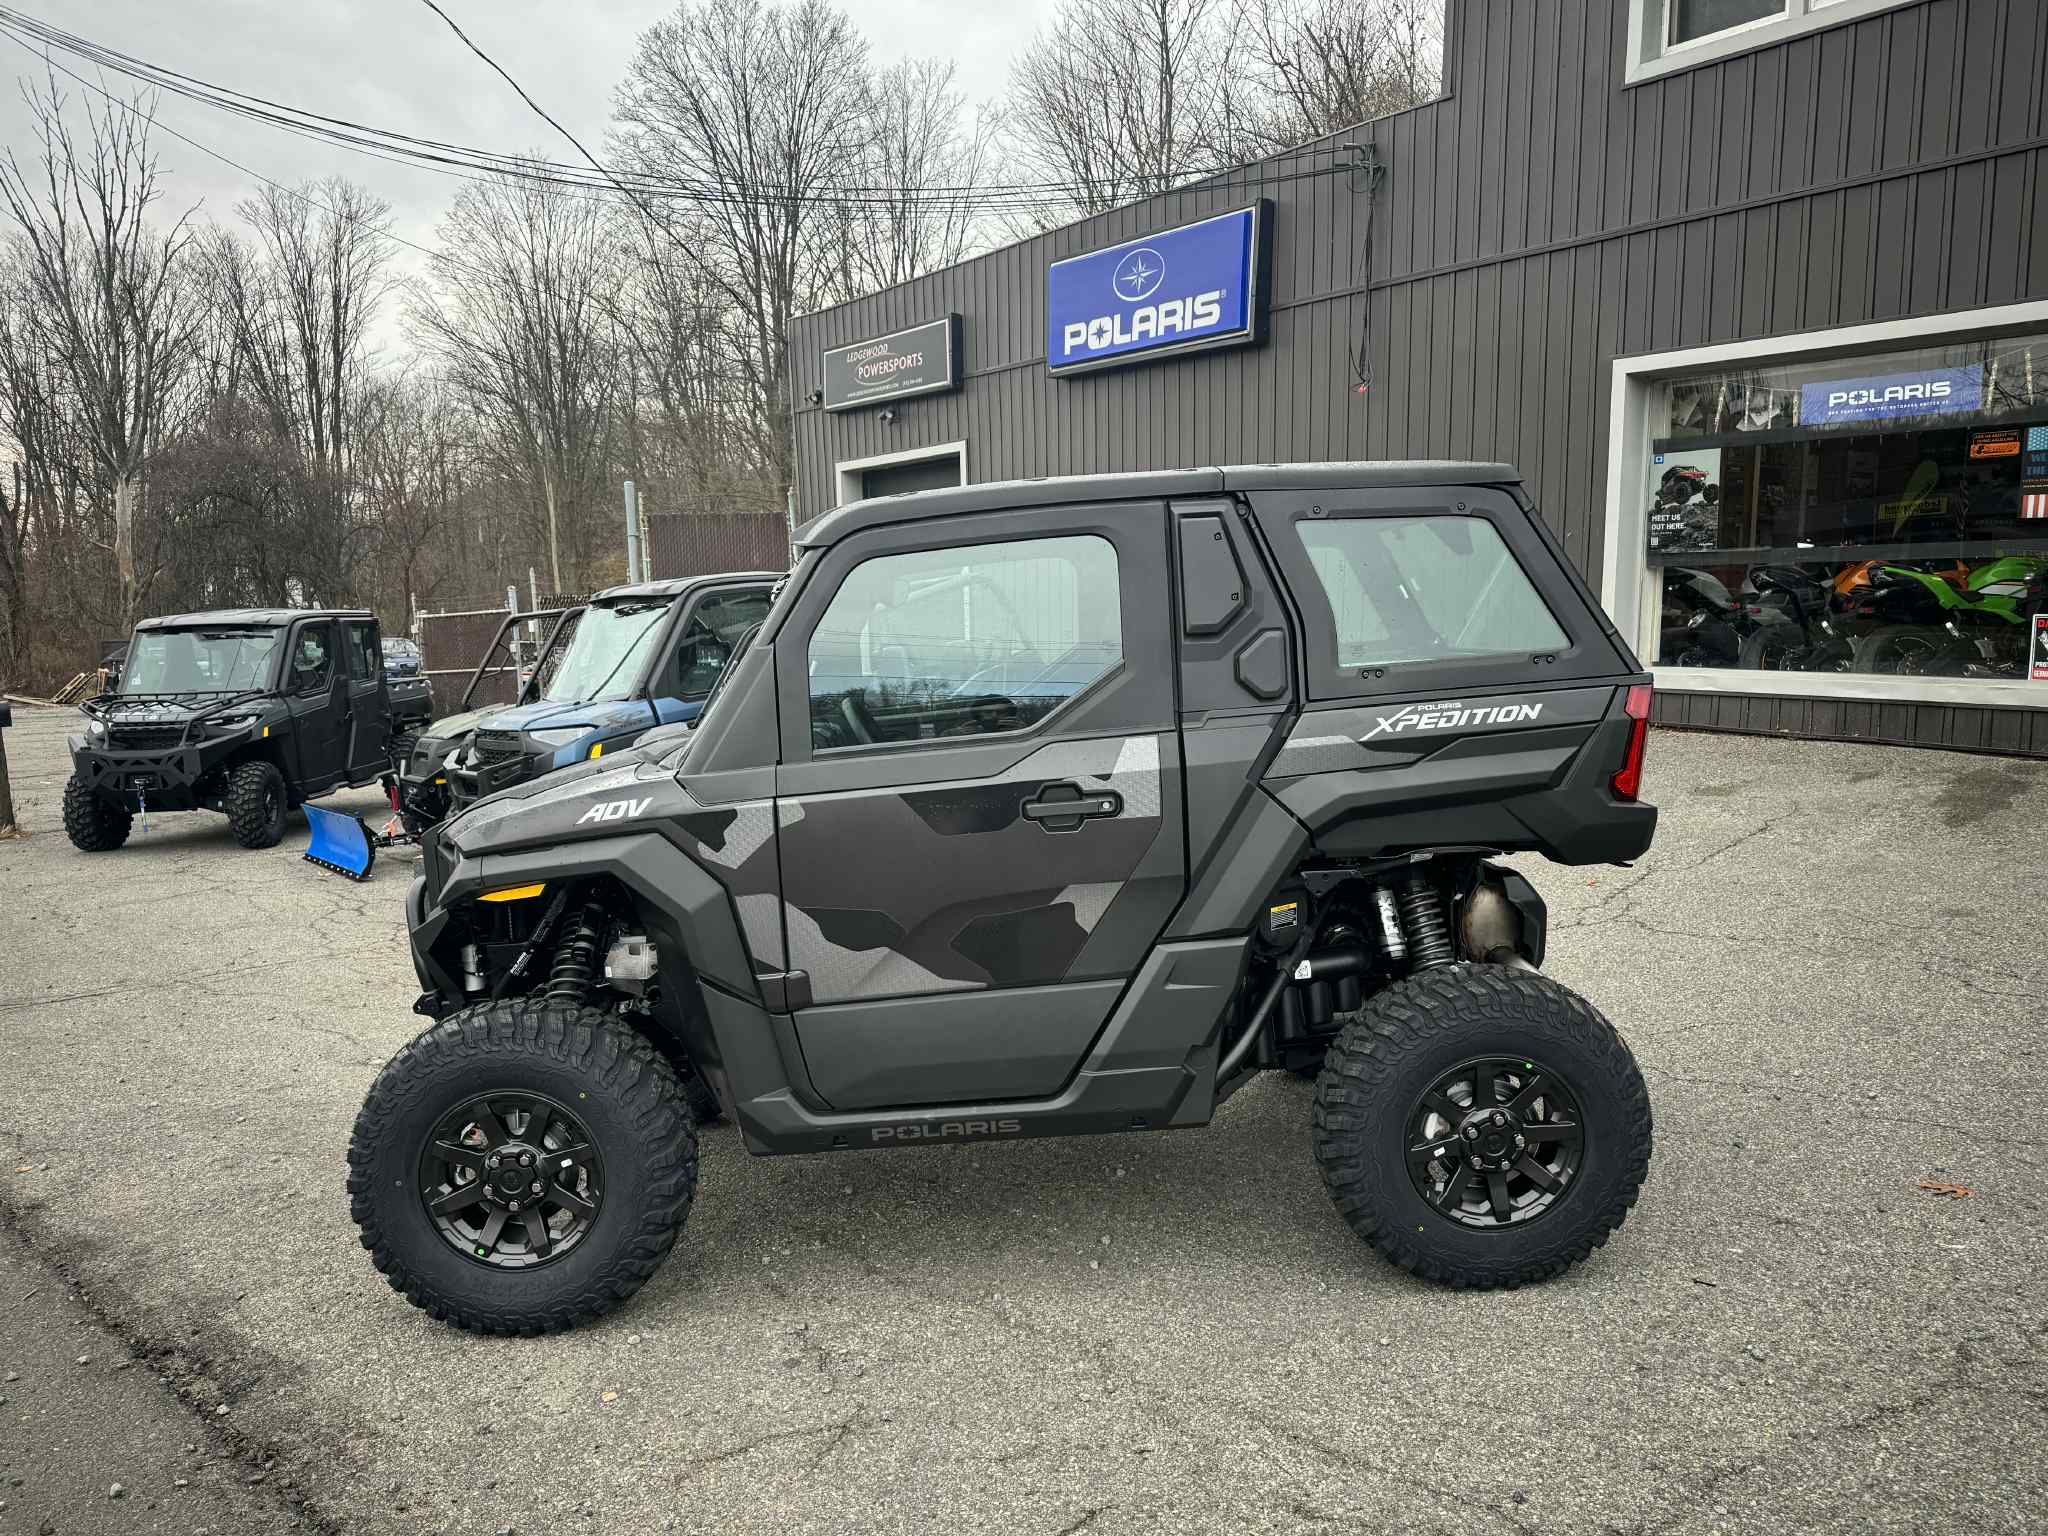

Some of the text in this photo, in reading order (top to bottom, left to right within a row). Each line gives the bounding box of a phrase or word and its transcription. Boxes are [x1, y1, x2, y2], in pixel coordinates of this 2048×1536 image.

[1064, 289, 1221, 355] POLARIS
[846, 344, 888, 363] LEDGEWOOD
[858, 352, 923, 378] POWERSPORTS
[1828, 381, 1951, 407] POLARIS
[1651, 513, 1681, 522] MEET US
[1417, 702, 1462, 712] POLARIS
[1357, 703, 1543, 742] XPEDITION
[575, 797, 654, 825] ADV
[872, 1119, 1023, 1141] POLARIS
